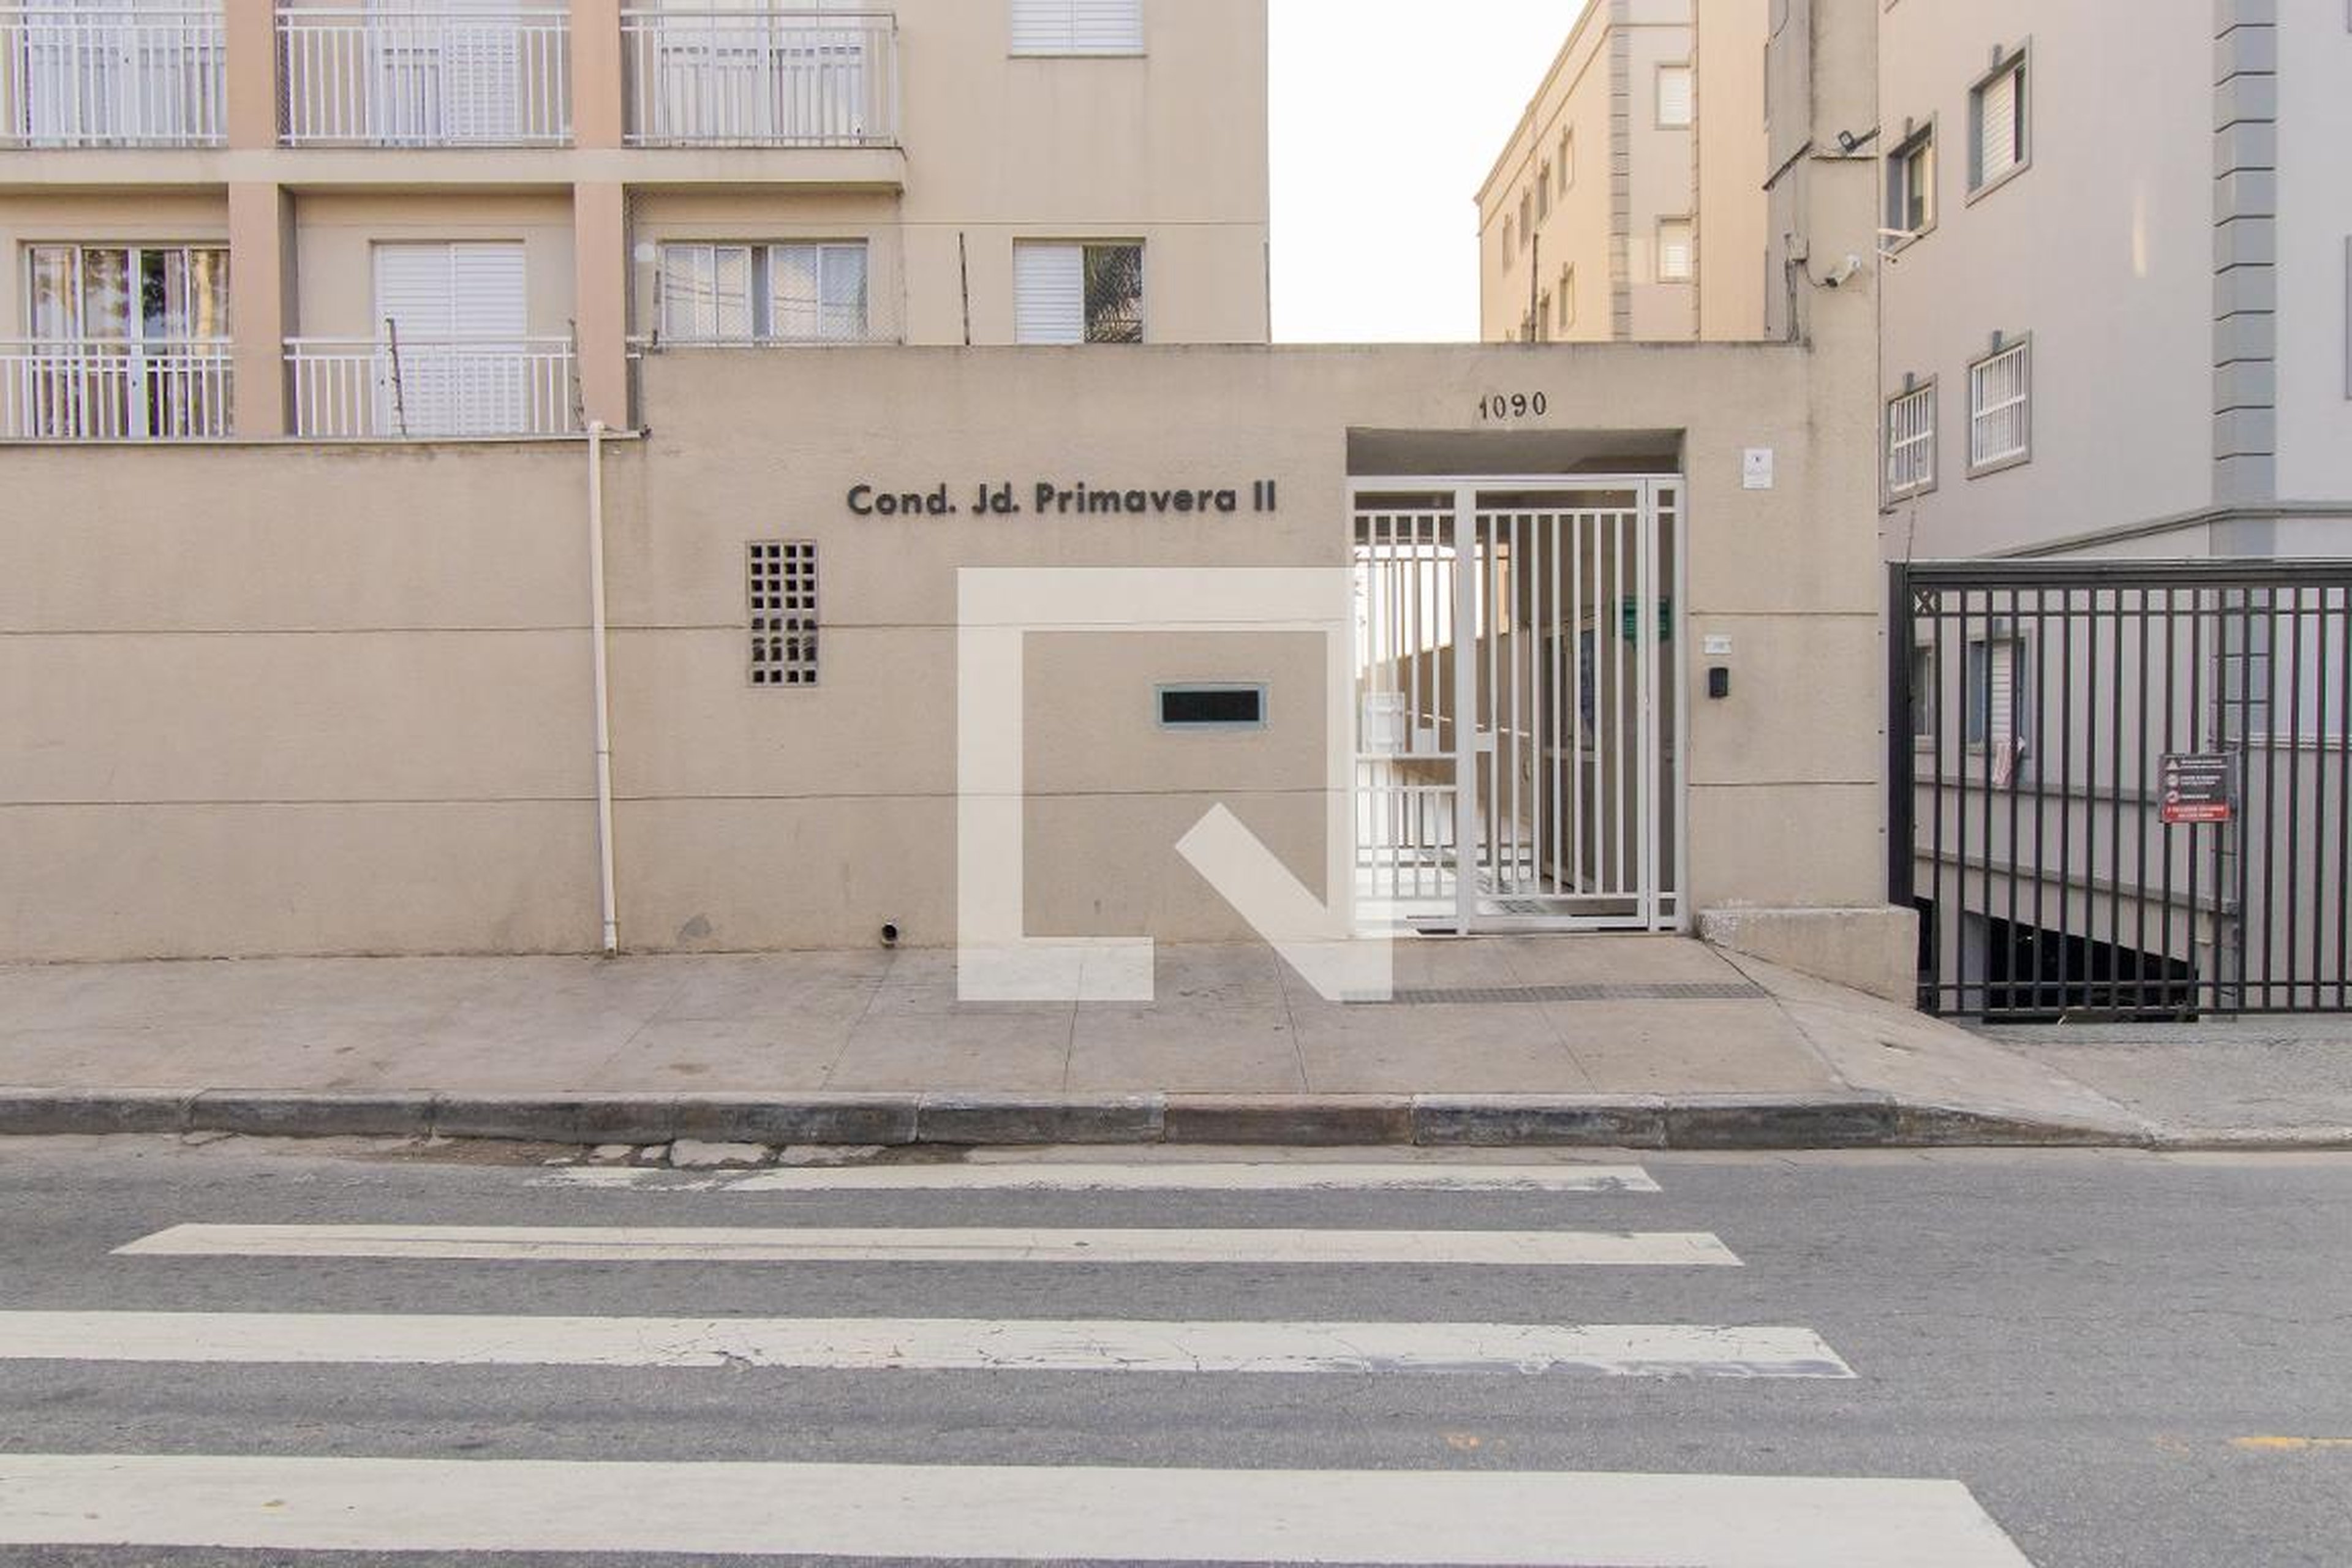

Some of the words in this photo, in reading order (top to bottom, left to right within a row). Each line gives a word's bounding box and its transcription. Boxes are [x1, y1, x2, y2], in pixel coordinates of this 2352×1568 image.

[1479, 391, 1547, 420] 1090
[846, 482, 957, 516] Cond.
[971, 481, 1020, 516] Jd.
[1035, 481, 1237, 514] Primavera
[1253, 480, 1276, 513] II
